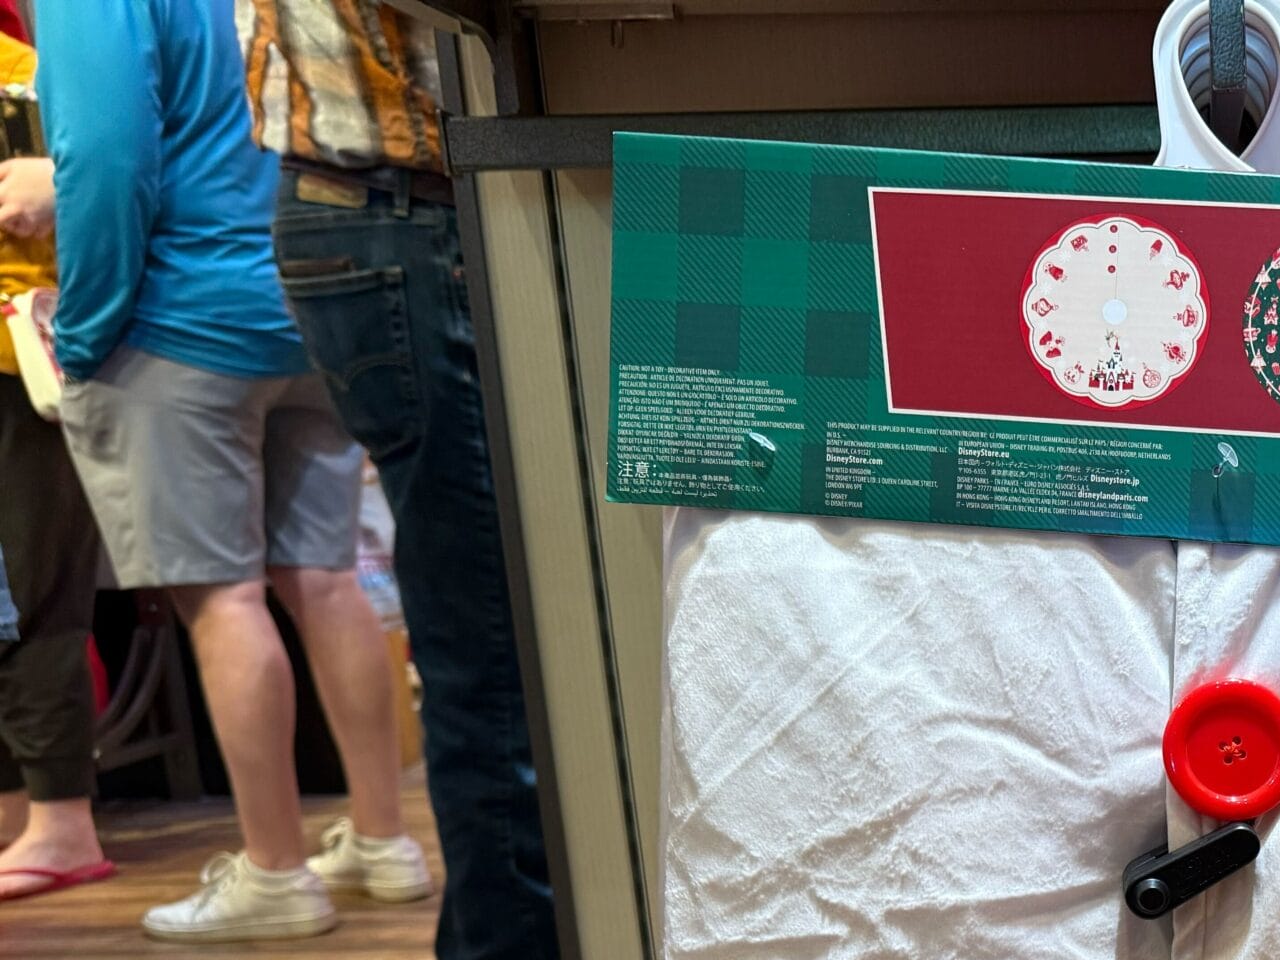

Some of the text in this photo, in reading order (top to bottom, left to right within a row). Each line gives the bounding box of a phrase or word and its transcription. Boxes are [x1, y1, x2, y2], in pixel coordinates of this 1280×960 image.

[958, 447, 1010, 459] DisneyStore.eu
[826, 454, 883, 466] DisneyStore.com
[1090, 474, 1140, 487] Disneystore.jp
[1078, 490, 1149, 503] disneylandparis.com
